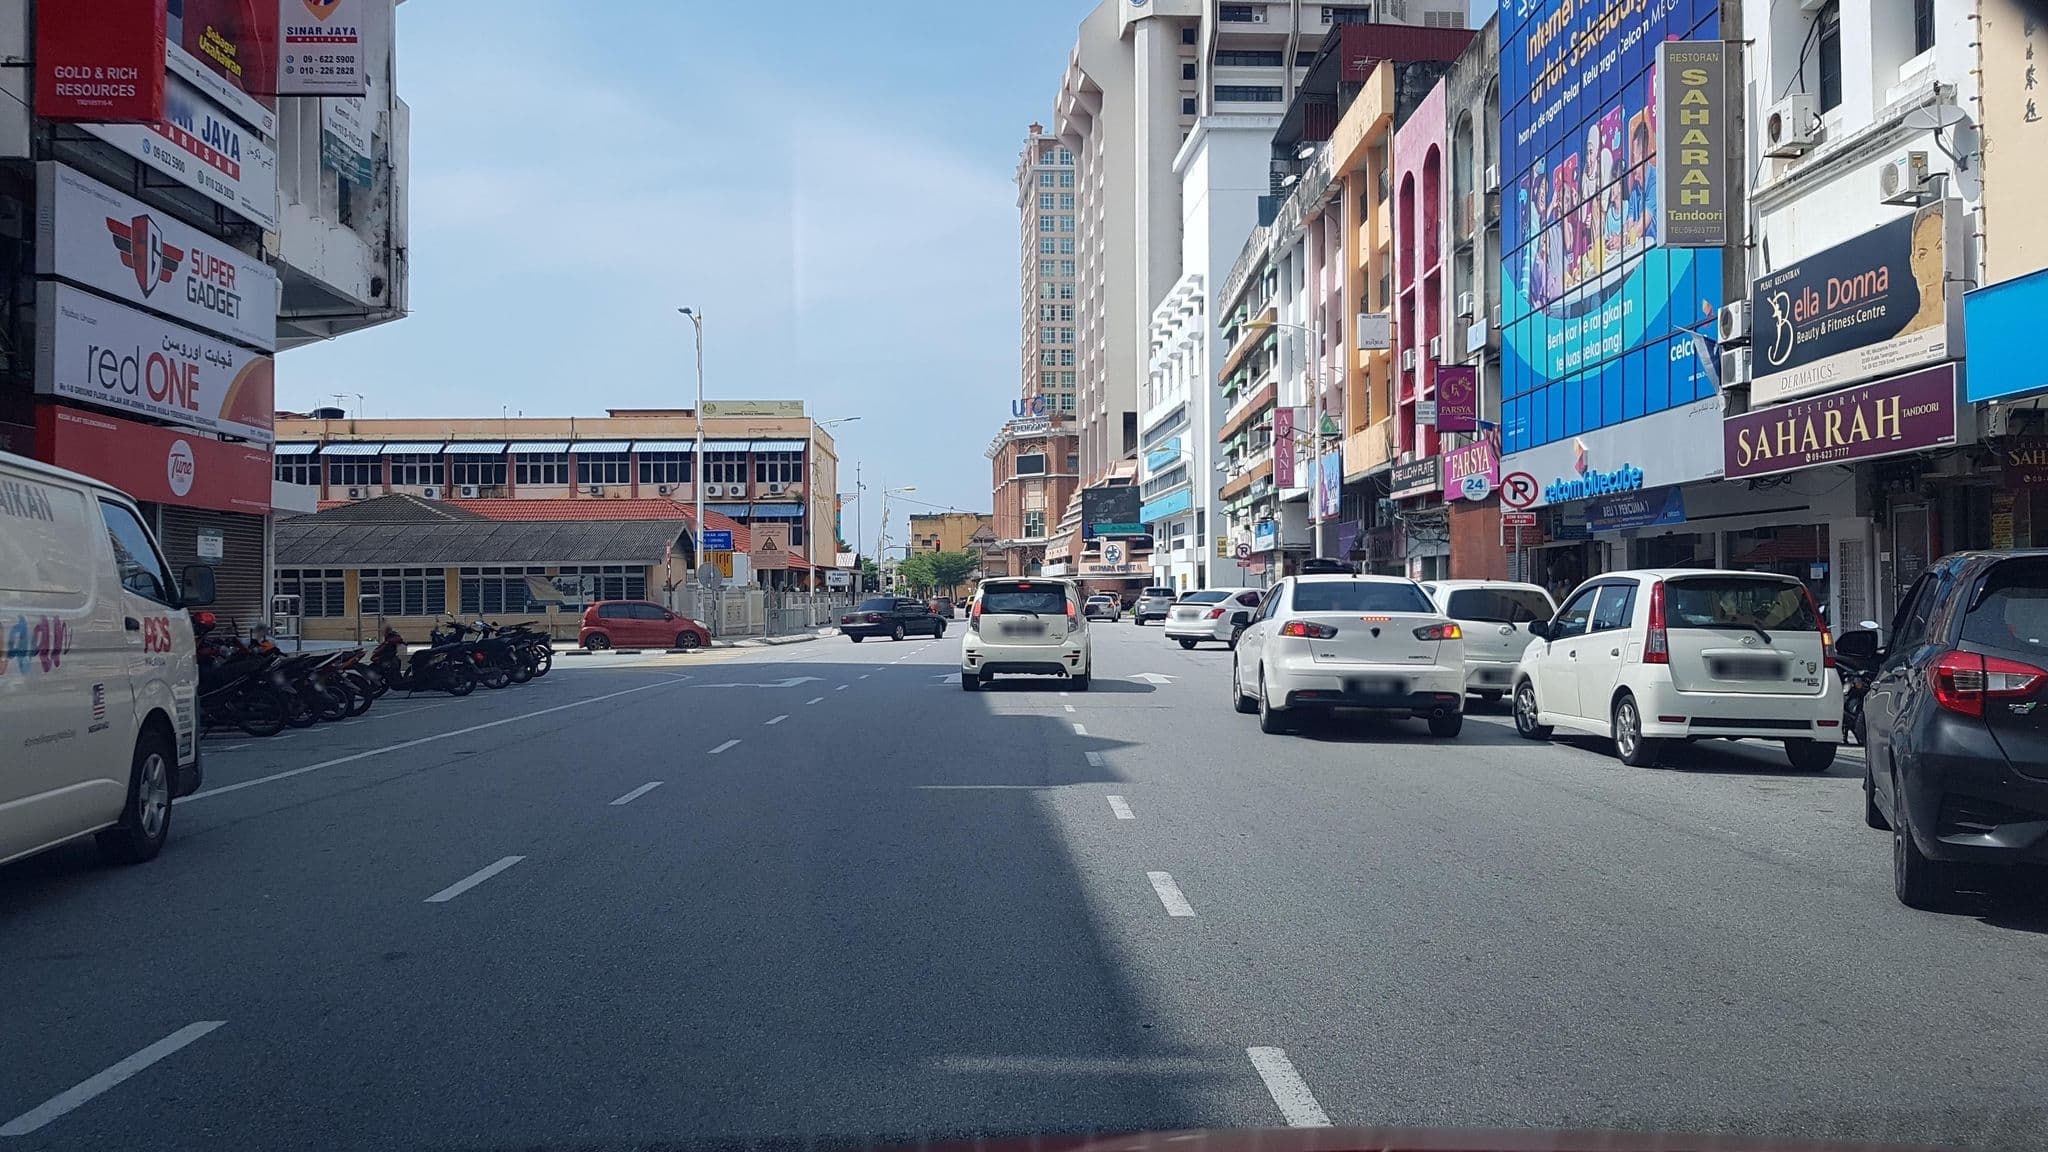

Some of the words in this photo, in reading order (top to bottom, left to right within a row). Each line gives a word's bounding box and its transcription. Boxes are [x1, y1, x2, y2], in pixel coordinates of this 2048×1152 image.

[286, 26, 323, 36] SINAR
[327, 26, 357, 36] JAYA
[1669, 53, 1720, 63] RESTORAN
[55, 66, 89, 80] GOLD
[95, 66, 104, 80] &
[107, 66, 138, 80] RICH
[56, 83, 136, 97] RESOURCES
[201, 115, 241, 163] JAYA
[1680, 68, 1711, 206] SAHARAH
[1668, 209, 1723, 222] Tandoori
[191, 247, 237, 292] SUPER
[187, 275, 242, 320] GADGET
[1826, 265, 1889, 311] Donna
[1796, 327, 1820, 345] Beauty
[1820, 321, 1827, 335] &
[1827, 313, 1856, 333] Fitness
[1856, 304, 1887, 324] Centre
[87, 343, 140, 397] red
[145, 350, 200, 412] ONE
[1781, 363, 1834, 391] DERMATICS
[1012, 396, 1047, 417] UTC
[1441, 406, 1472, 414] FARSYA
[1787, 390, 1870, 419] RESTORAN
[1736, 394, 1902, 468] SAHARAH
[1902, 401, 1940, 418] TANDOORI
[169, 453, 193, 480] Tune
[1451, 445, 1491, 480] FARSYA
[2008, 450, 2048, 467] SAH
[1466, 478, 1485, 491] 24
